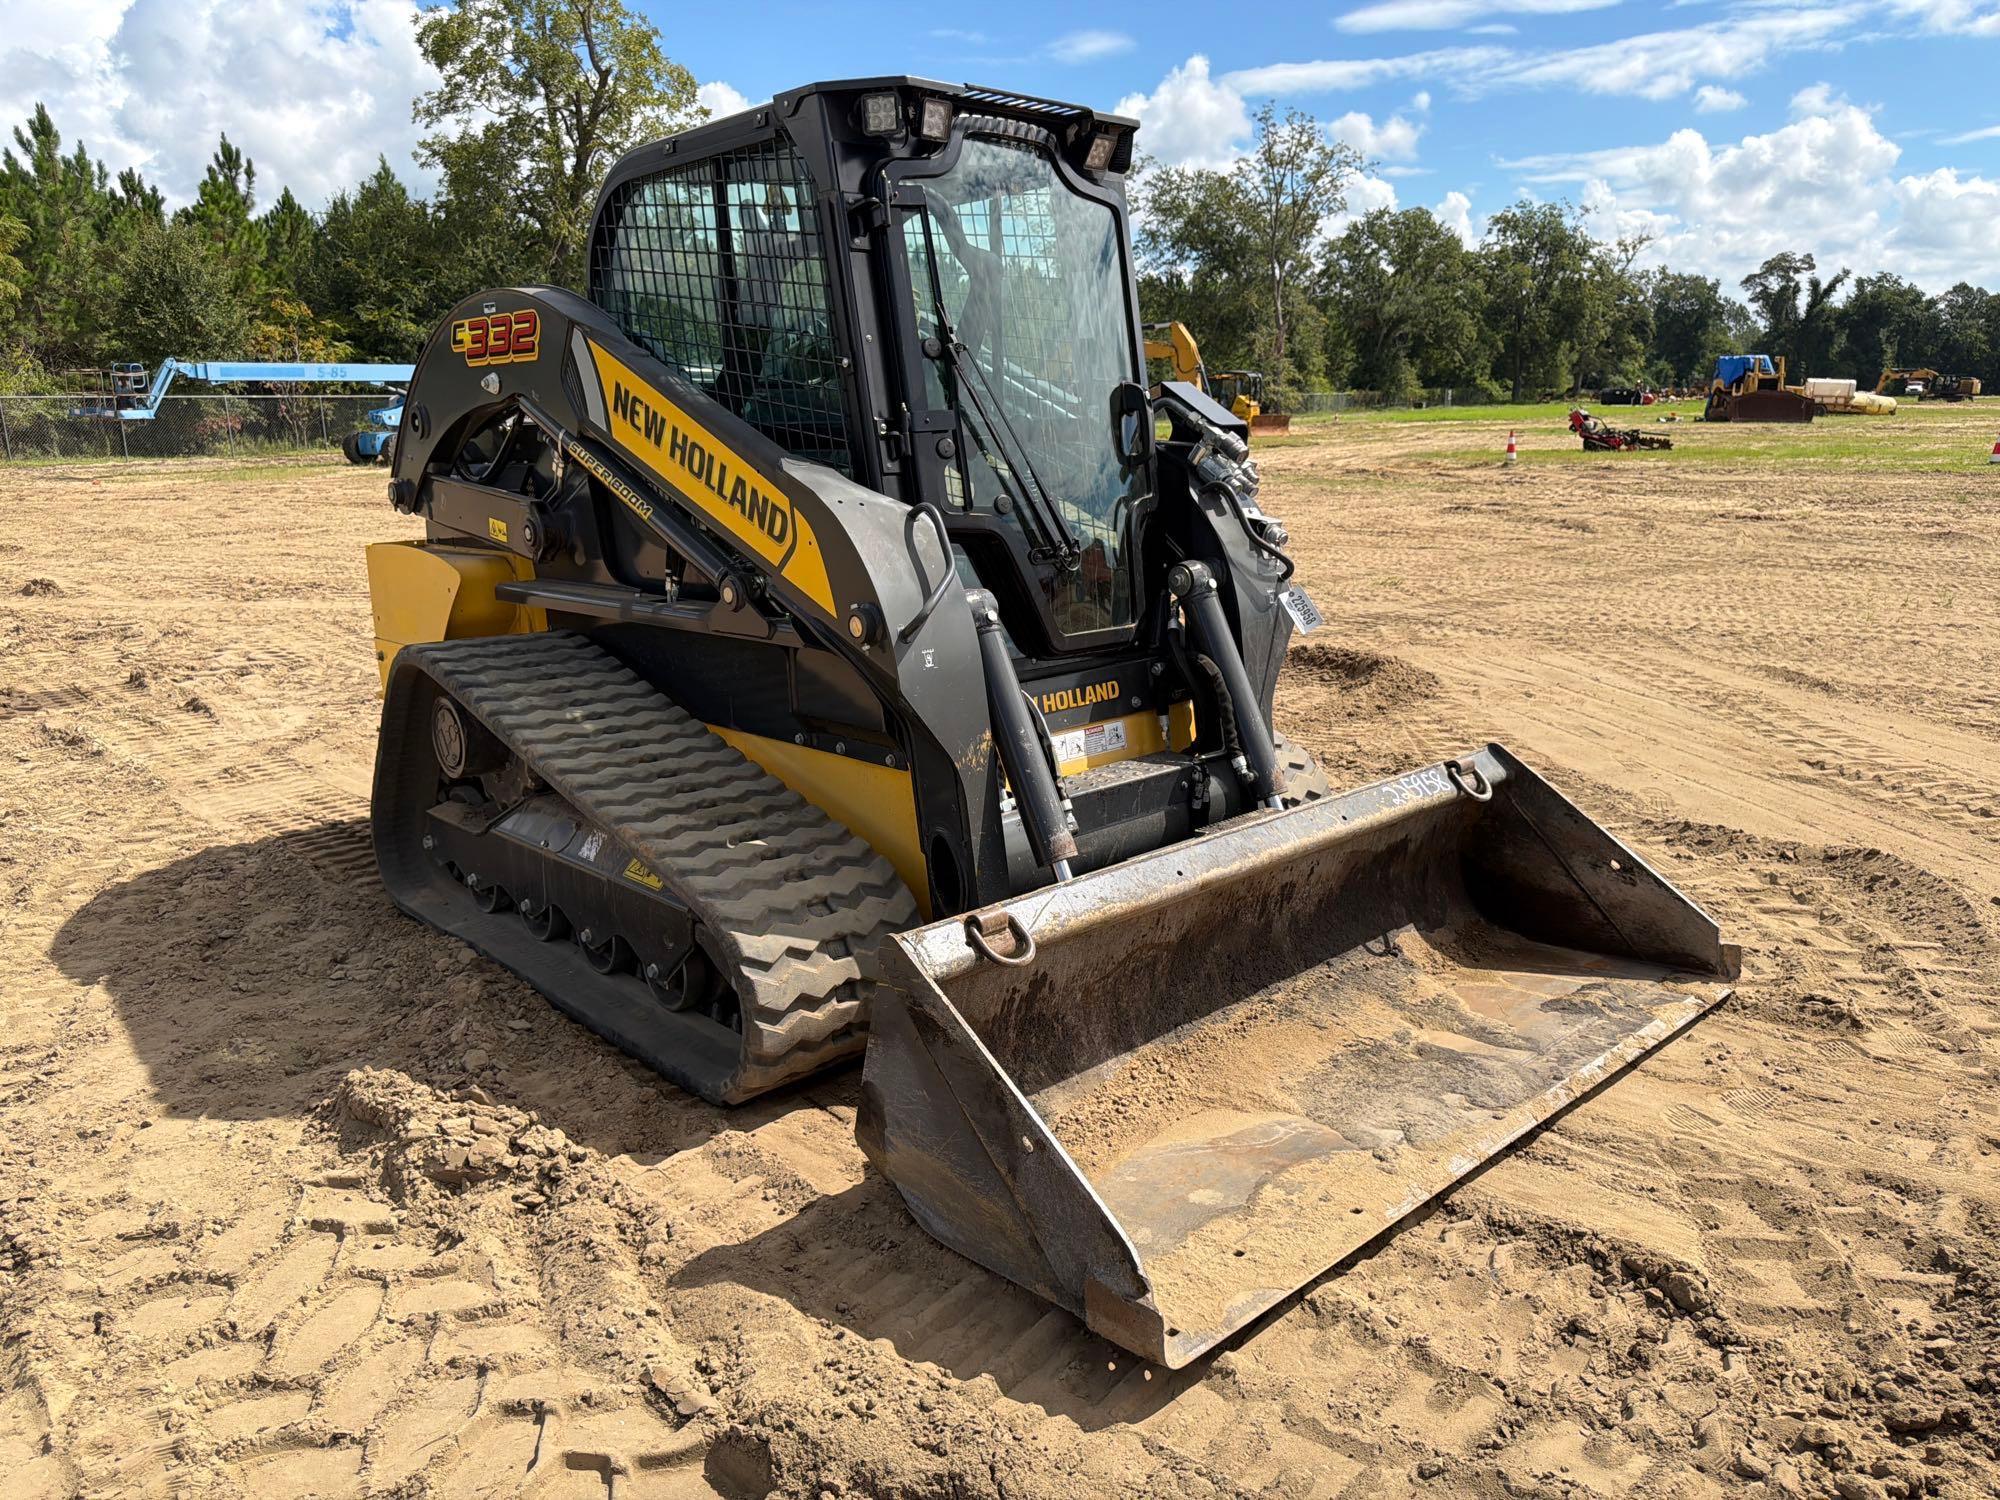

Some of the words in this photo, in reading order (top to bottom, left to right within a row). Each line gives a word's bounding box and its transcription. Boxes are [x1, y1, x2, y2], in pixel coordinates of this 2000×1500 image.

[451, 309, 540, 366] C332
[317, 366, 348, 378] S-85
[613, 380, 666, 449] NEW
[669, 424, 789, 545] HOLLAND
[1291, 595, 1317, 626] 225958
[1042, 680, 1120, 714] HOLLAND
[1382, 770, 1451, 805] 225958
